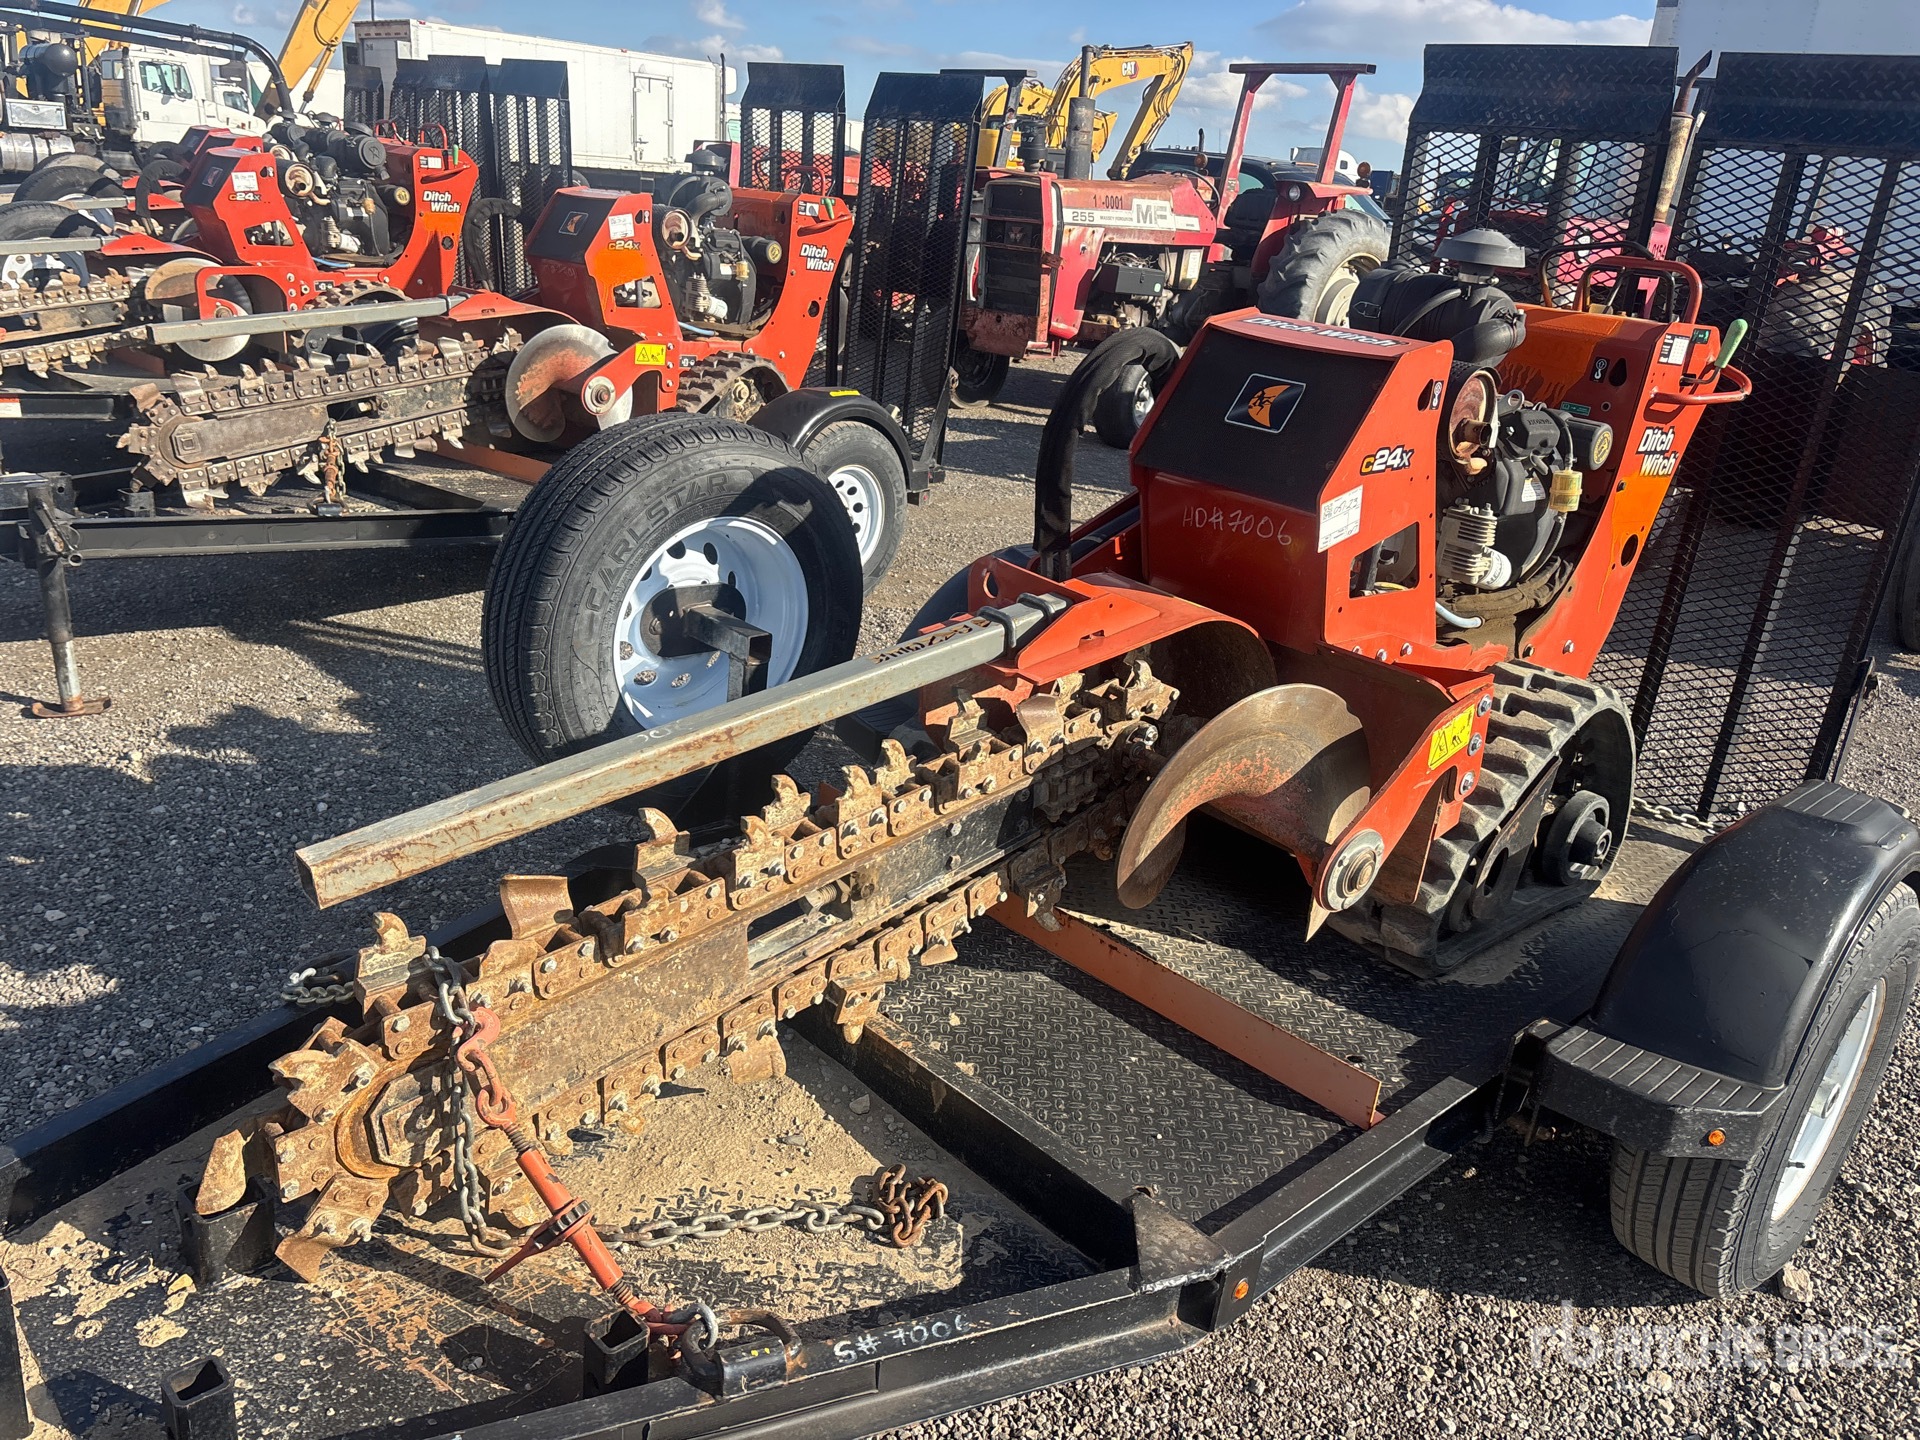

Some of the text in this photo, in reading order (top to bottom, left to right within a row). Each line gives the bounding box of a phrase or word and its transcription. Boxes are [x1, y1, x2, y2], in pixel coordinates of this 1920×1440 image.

[1121, 61, 1136, 77] CAT
[423, 190, 452, 202] Ditch
[431, 202, 461, 213] Witch
[1071, 211, 1095, 223] 255
[1136, 203, 1168, 225] MF
[800, 243, 828, 258] Ditch
[807, 257, 835, 272] Witch
[1242, 317, 1400, 347] Ditch Witch
[1637, 427, 1675, 452] Ditch
[1361, 446, 1413, 474] C24X
[1640, 453, 1676, 477] Witch
[586, 472, 728, 612] CARLSTAR
